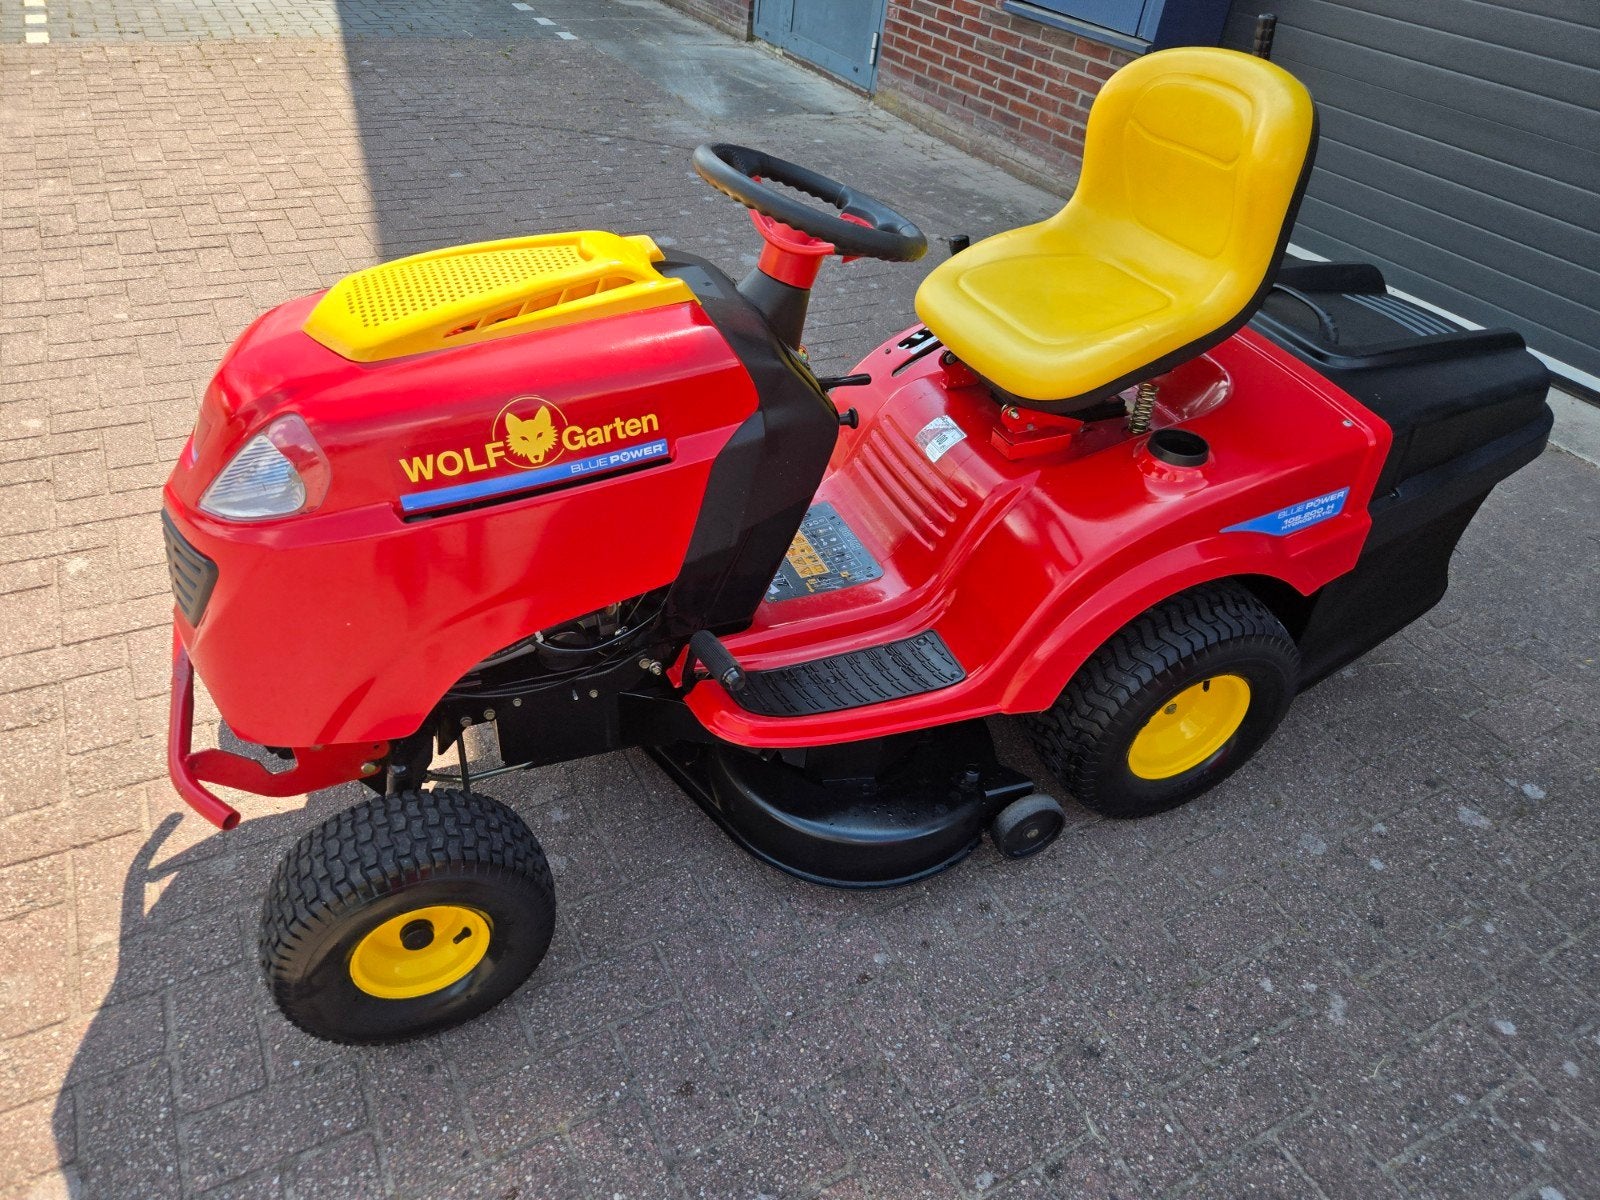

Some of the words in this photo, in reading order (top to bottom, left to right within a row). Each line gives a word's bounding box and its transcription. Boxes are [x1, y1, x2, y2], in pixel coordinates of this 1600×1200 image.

[399, 441, 505, 483] WOLF
[561, 413, 659, 451] Garten
[571, 457, 608, 474] BLUE
[1278, 503, 1306, 519] BLUE
[1305, 490, 1345, 509] POWER
[1281, 509, 1333, 531] HYDROSTATIC
